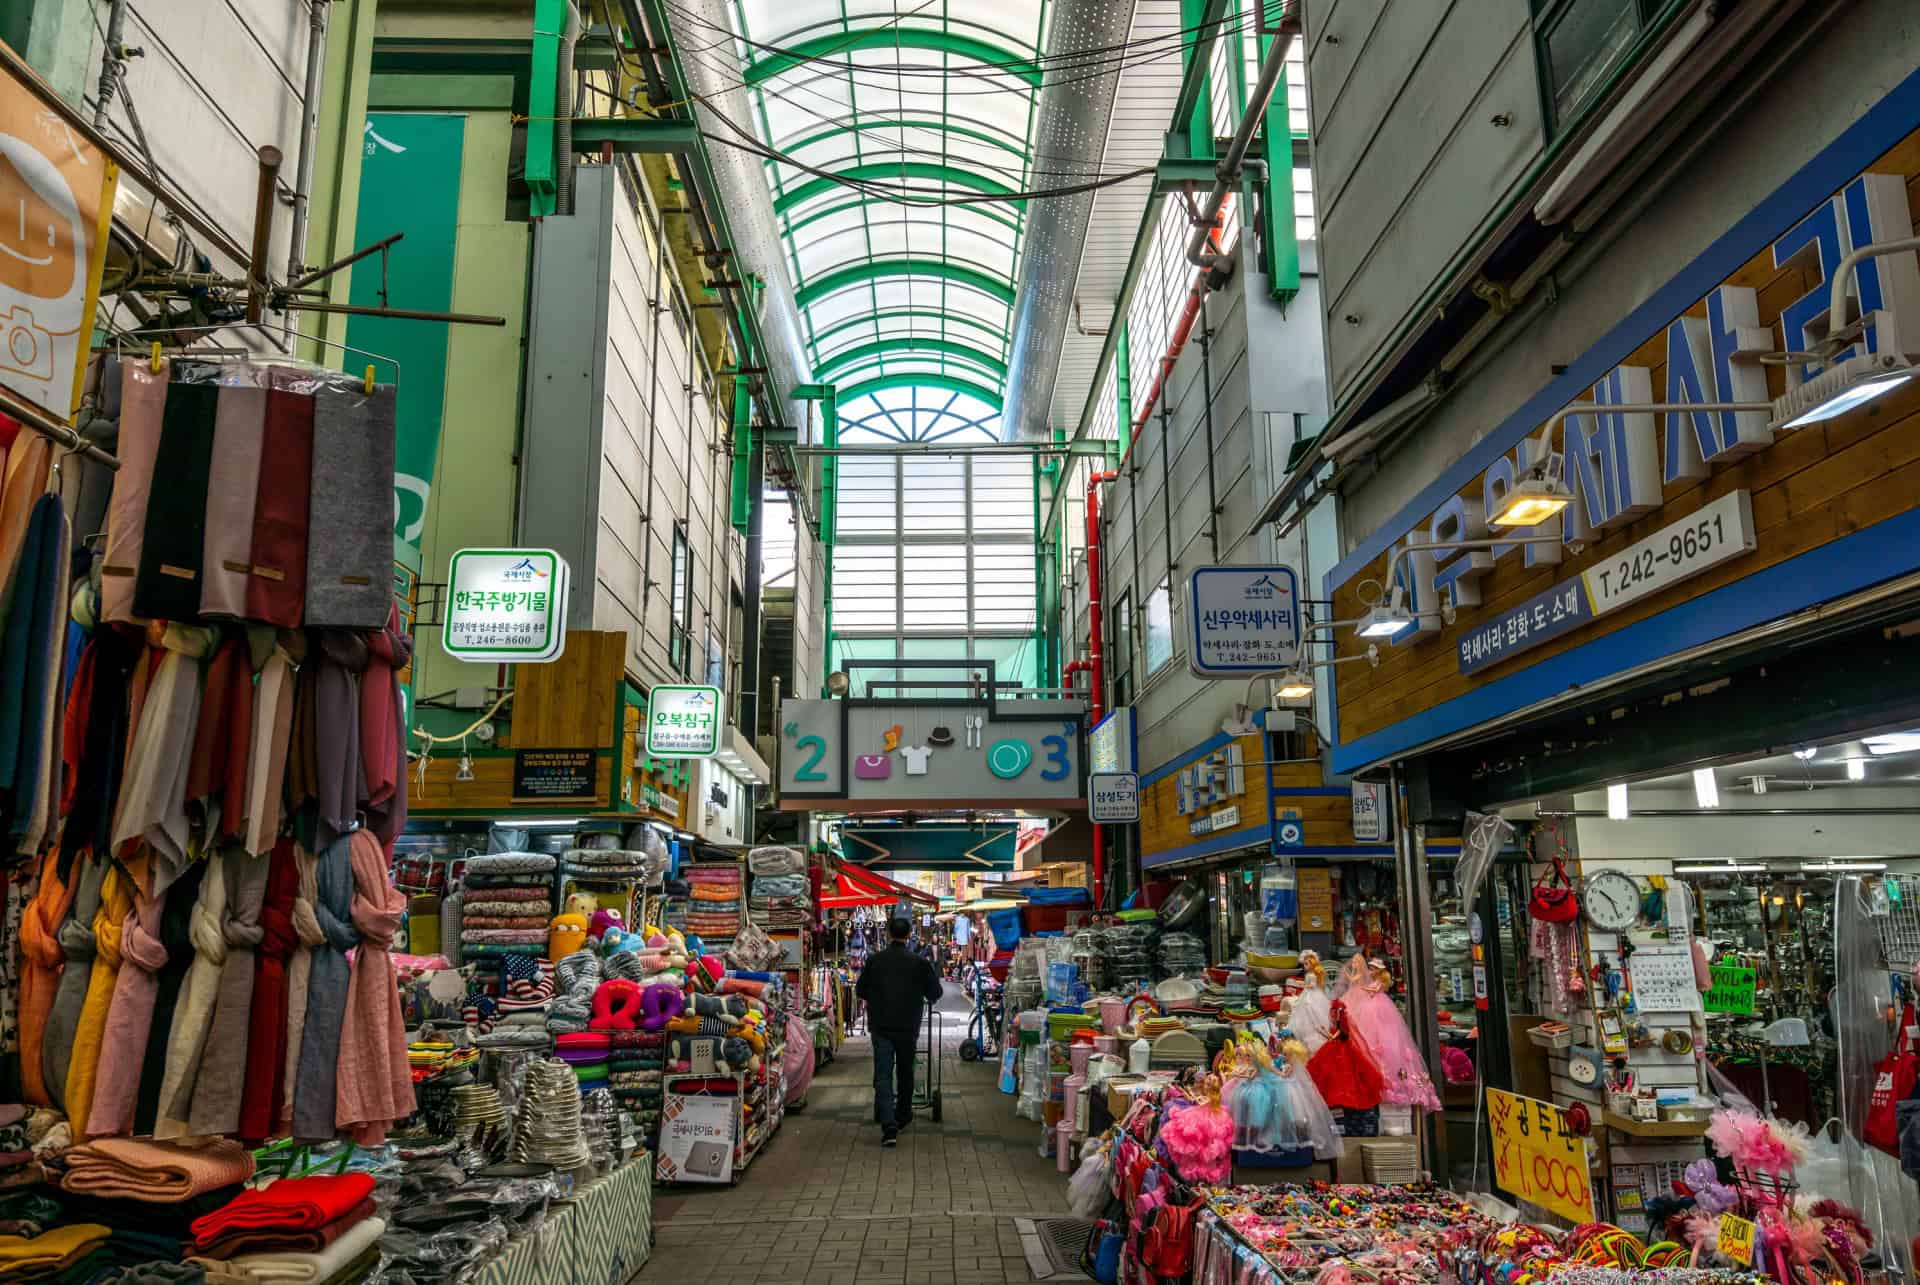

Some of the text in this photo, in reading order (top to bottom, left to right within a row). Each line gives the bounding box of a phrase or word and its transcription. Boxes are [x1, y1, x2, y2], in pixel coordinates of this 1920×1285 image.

[1599, 513, 1724, 599] T.242-9651
[455, 591, 547, 612] 한국주방기물
[1203, 609, 1291, 631] 신우악세사리
[655, 712, 712, 728] 오복침구
